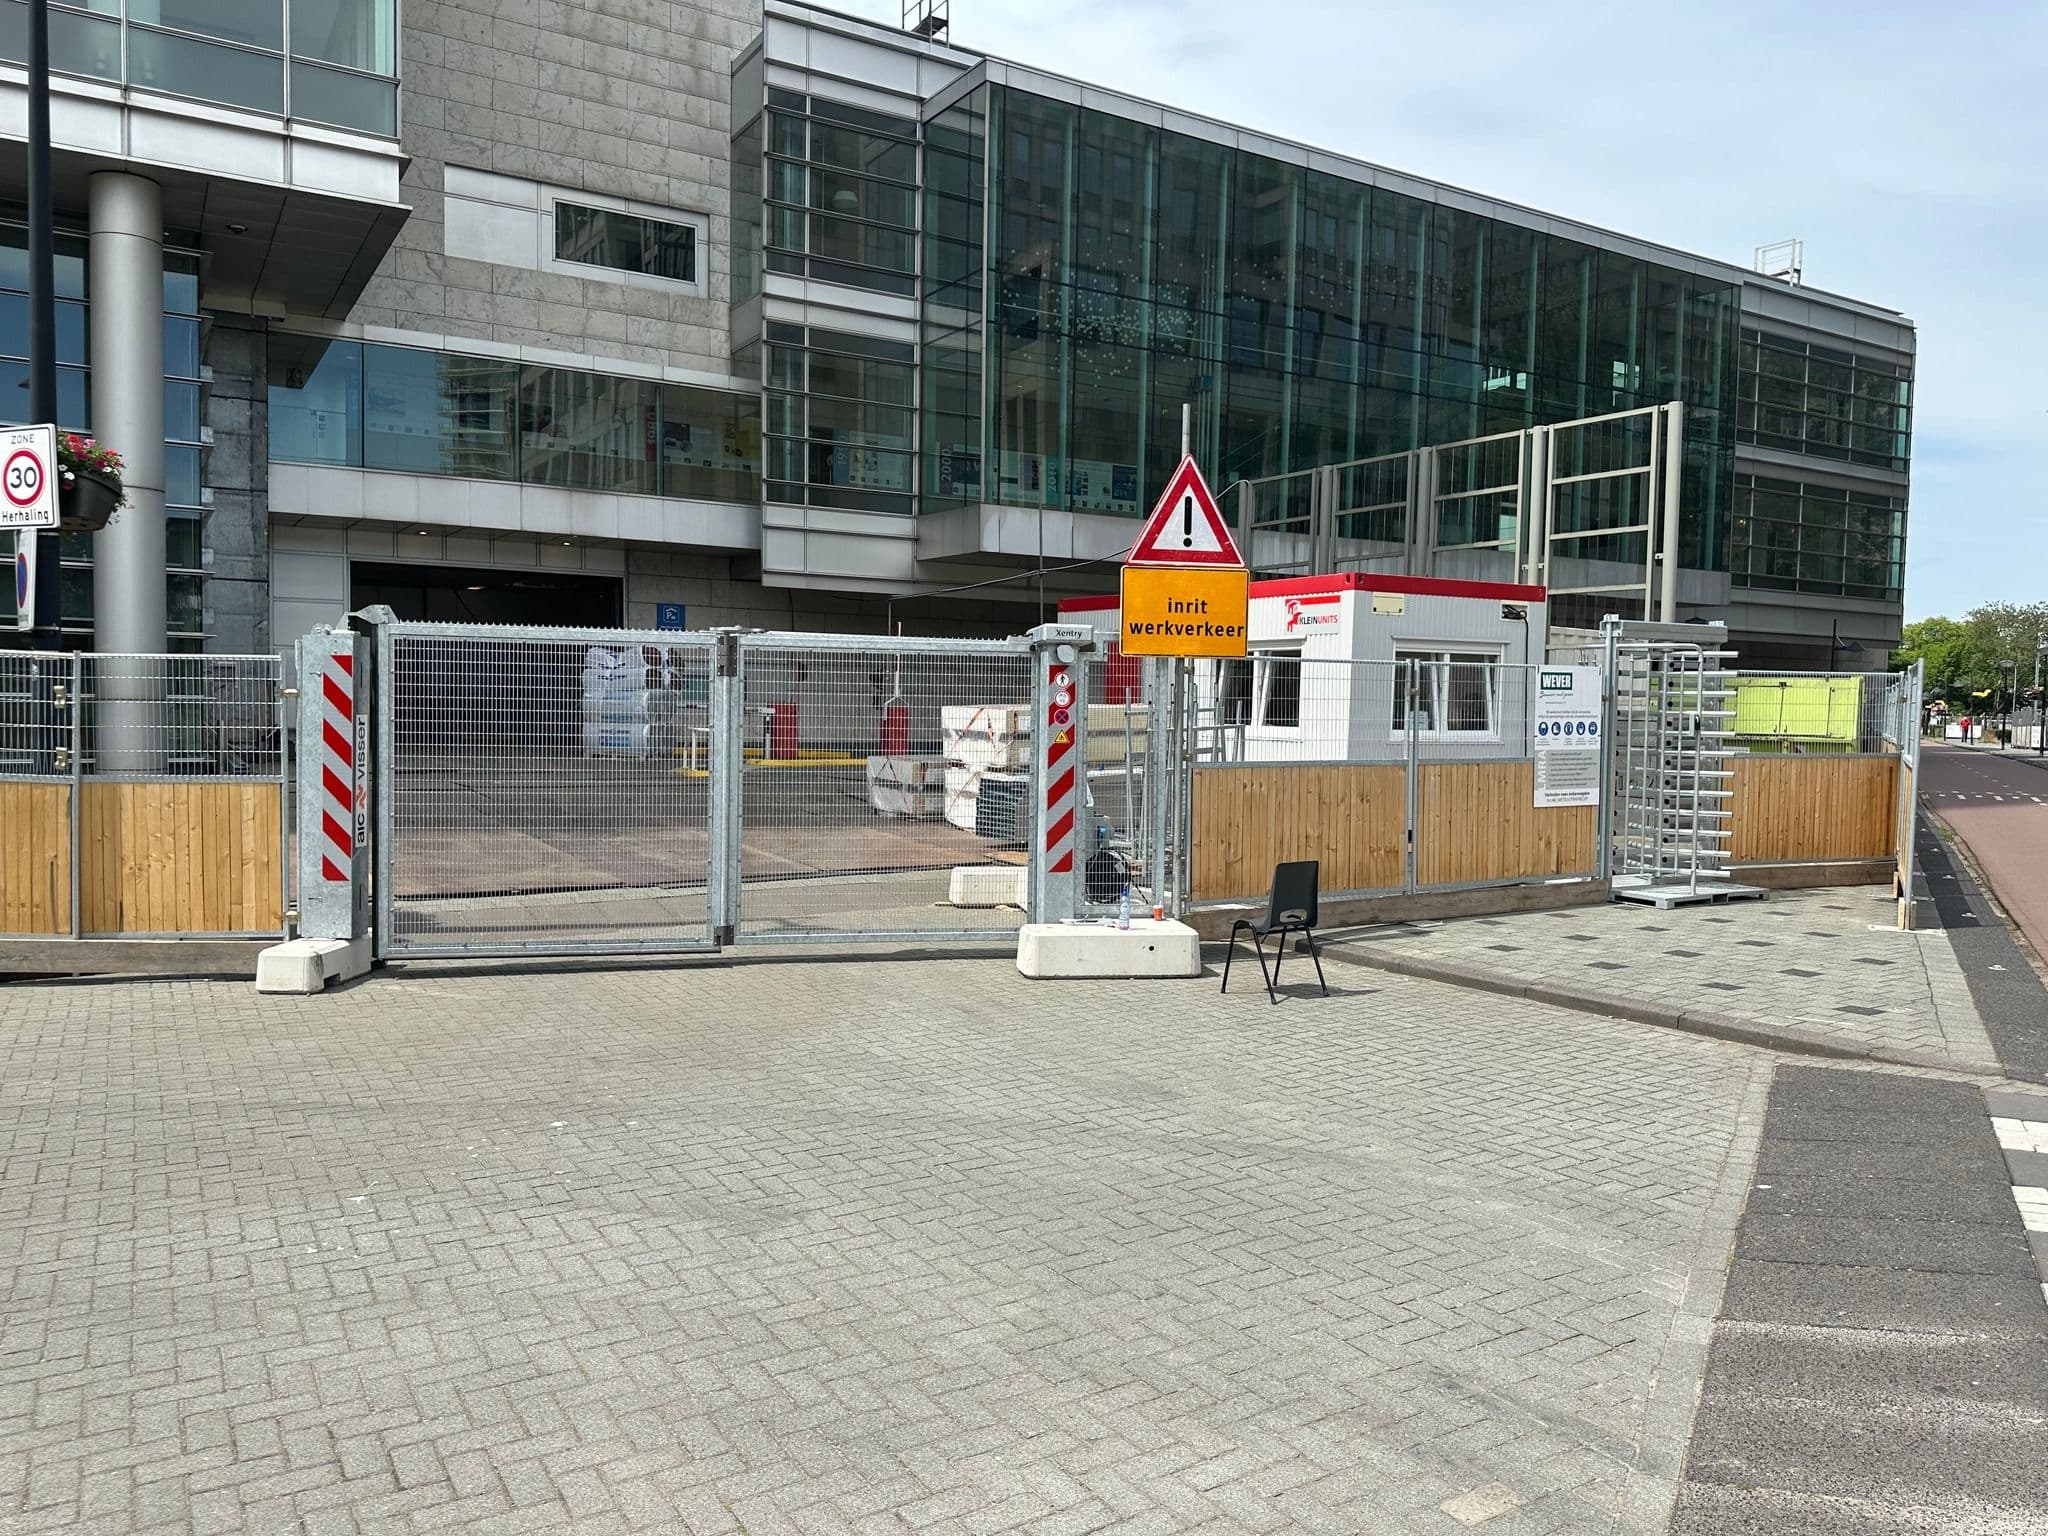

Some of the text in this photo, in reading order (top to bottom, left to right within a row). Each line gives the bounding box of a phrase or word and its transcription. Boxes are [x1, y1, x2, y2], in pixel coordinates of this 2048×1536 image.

[11, 434, 35, 444] ZONE
[10, 467, 37, 488] 30
[1047, 462, 1057, 492] 2010
[2, 509, 49, 523] Herhaling
[1167, 597, 1208, 614] inrit
[1055, 629, 1083, 639] Xentry
[1129, 620, 1244, 637] werkverkeer
[1542, 674, 1571, 688] WEVER
[357, 717, 365, 780] visser
